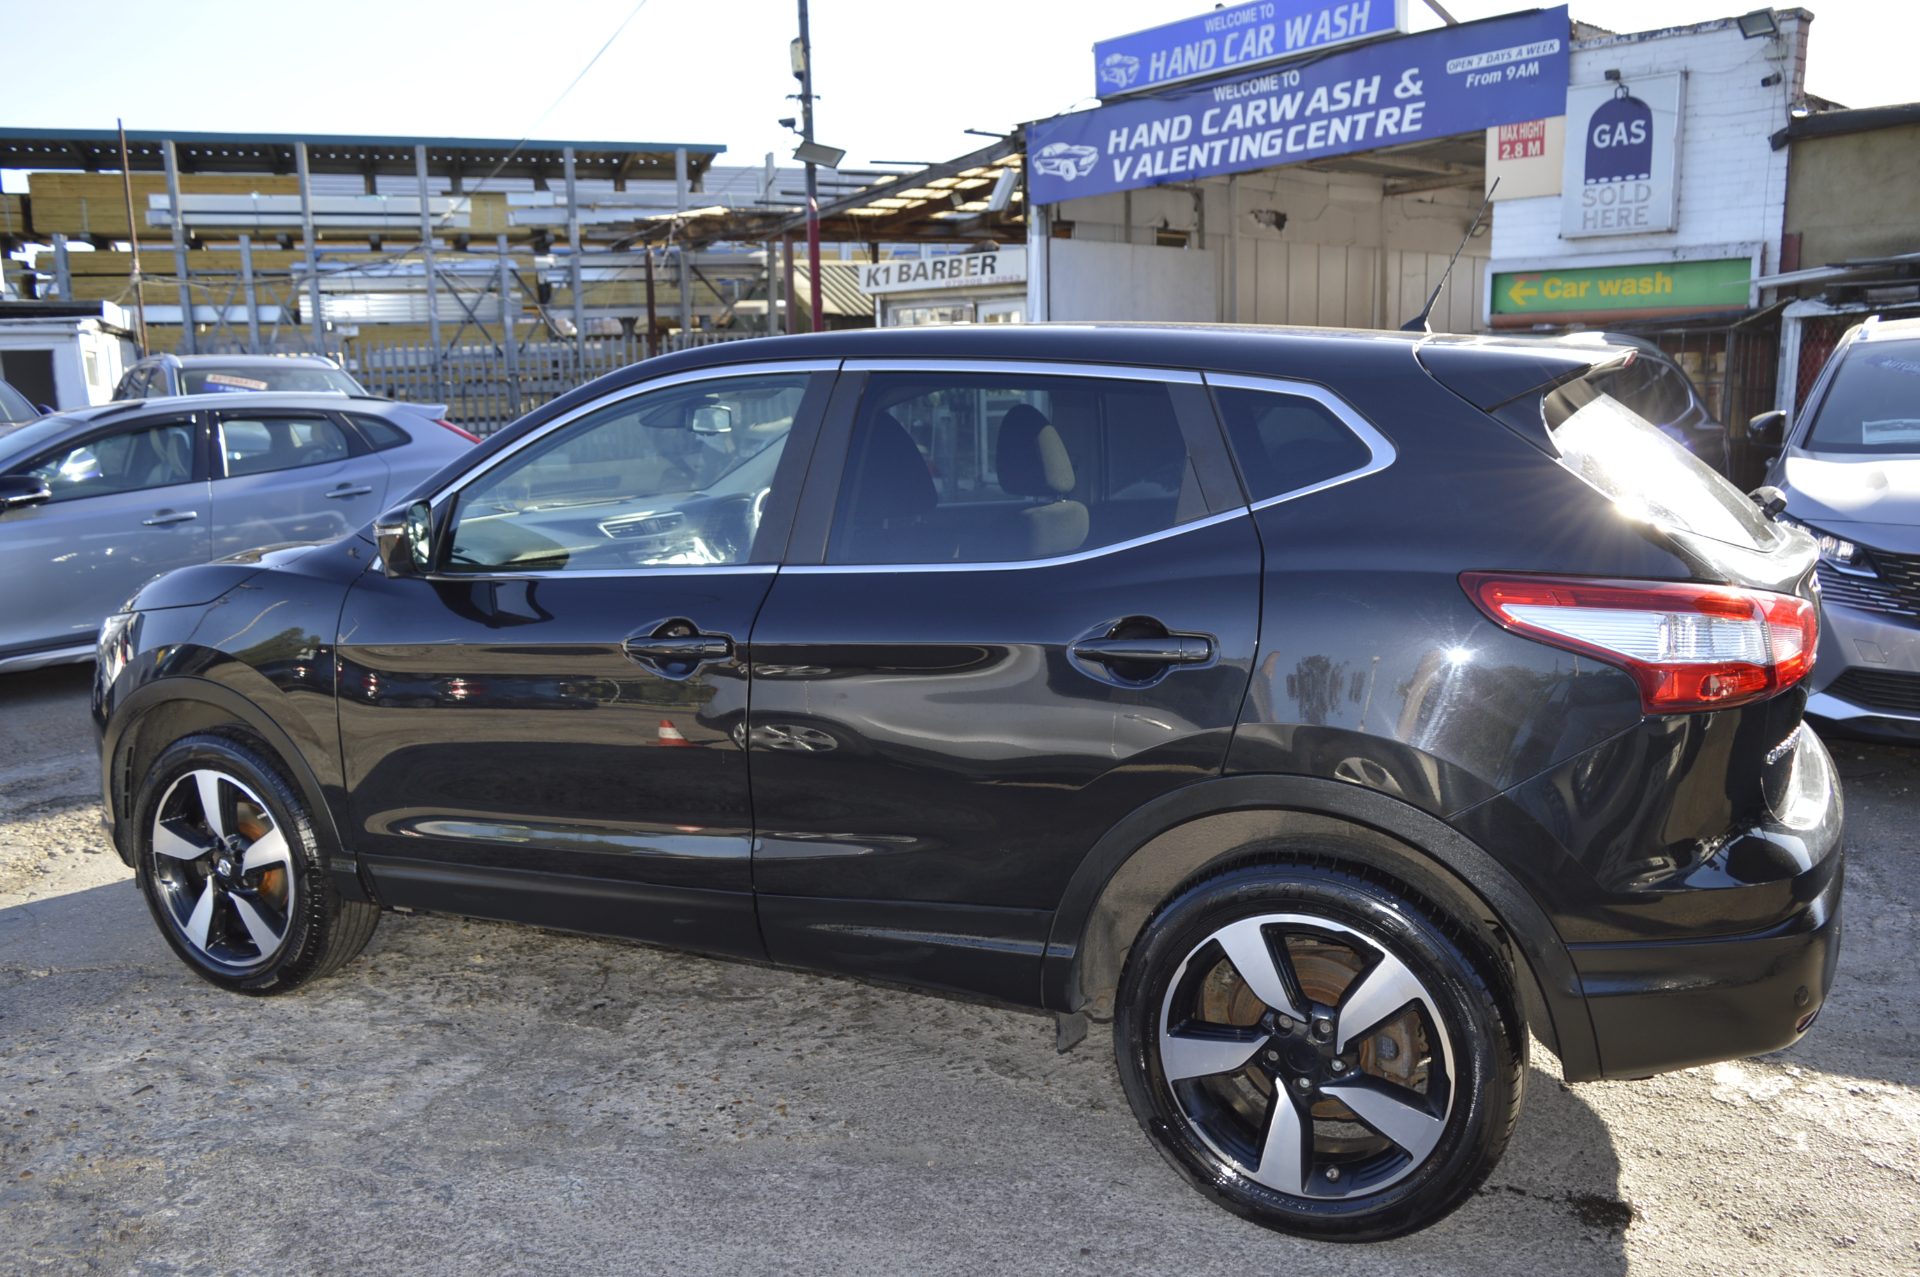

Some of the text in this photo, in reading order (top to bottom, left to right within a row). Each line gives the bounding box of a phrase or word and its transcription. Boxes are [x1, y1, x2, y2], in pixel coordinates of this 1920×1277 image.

[1204, 3, 1274, 33] WELCOME TO
[1149, 1, 1370, 82] HAND CAR WASH
[1448, 59, 1474, 72] OPEN
[1486, 51, 1513, 64] DAYS
[1515, 48, 1523, 59] A
[1526, 41, 1556, 56] WEEK
[1213, 69, 1300, 102] WELCOME TO
[1465, 61, 1539, 88] From 9AM
[1107, 114, 1192, 154] HAND
[1393, 67, 1423, 99] &
[1500, 120, 1545, 142] MAX HIGHT
[1593, 119, 1646, 148] GAS
[1502, 141, 1541, 159] 2.8 M
[1582, 183, 1651, 208] SOLD
[1583, 205, 1648, 230] HERE
[866, 254, 997, 288] K1 BARBER
[1543, 271, 1673, 299] Car wash
